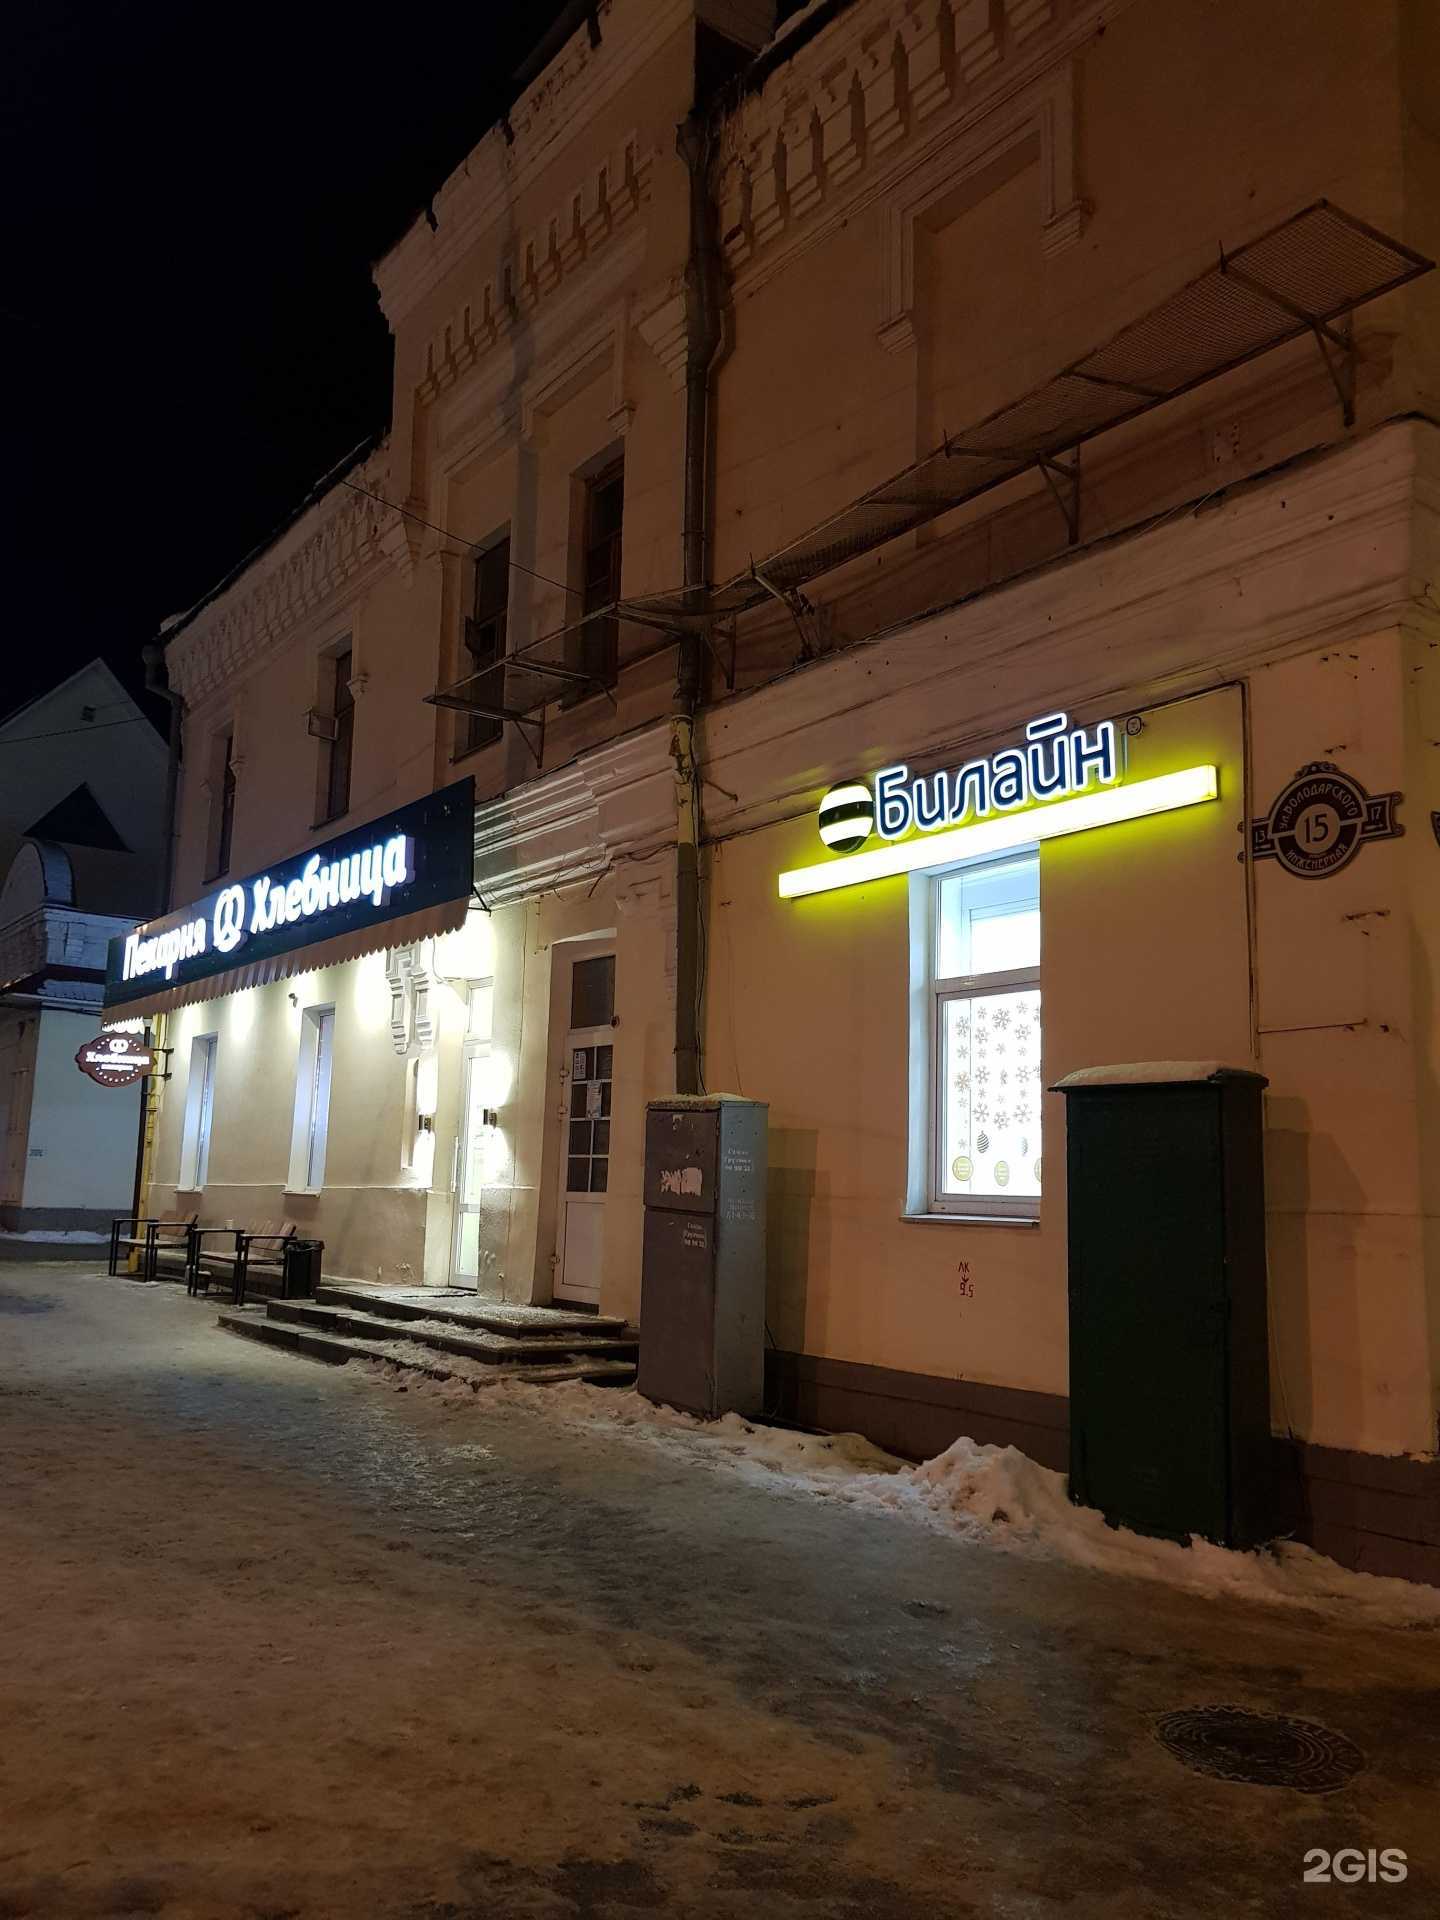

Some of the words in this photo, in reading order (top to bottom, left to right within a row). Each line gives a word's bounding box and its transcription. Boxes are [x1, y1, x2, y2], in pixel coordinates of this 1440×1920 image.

[875, 712, 1116, 841] Билайн
[1370, 806, 1381, 821] 17
[1304, 813, 1329, 843] 15
[122, 917, 206, 981] Пекарня
[250, 834, 408, 935] Хлебница
